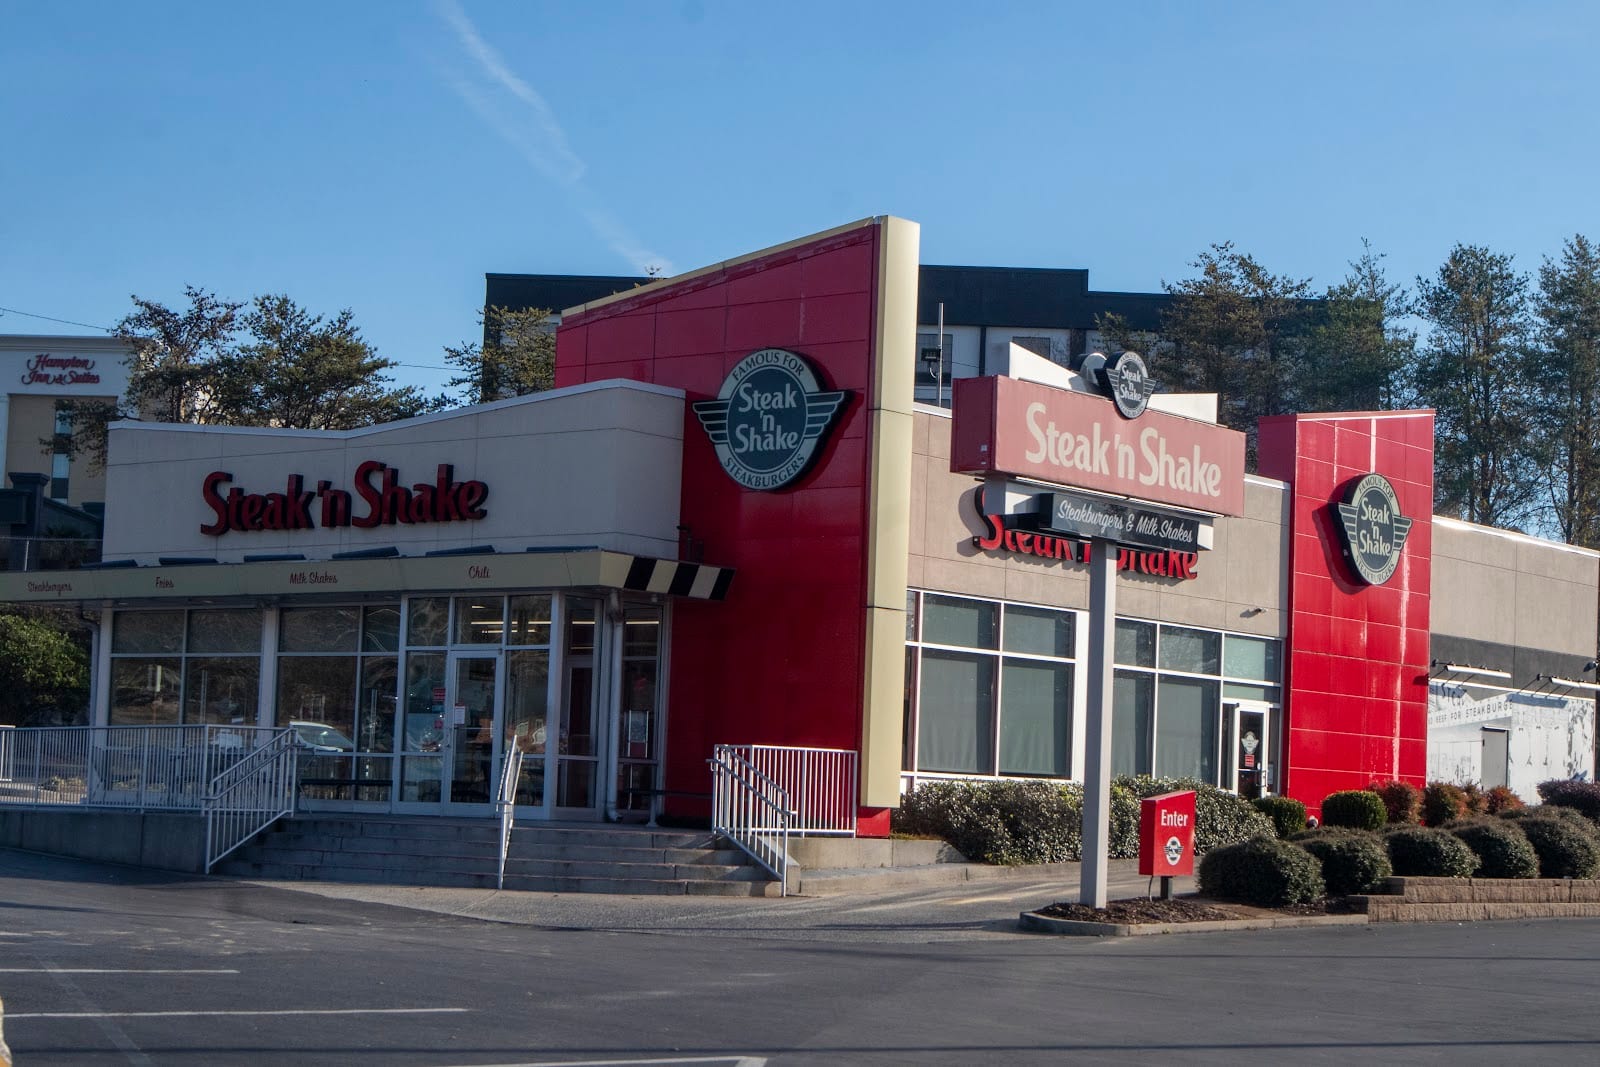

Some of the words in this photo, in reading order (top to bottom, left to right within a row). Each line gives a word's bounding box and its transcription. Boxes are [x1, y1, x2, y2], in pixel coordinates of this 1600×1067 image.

[26, 353, 95, 371] Hampton
[732, 352, 780, 381] FAMOUS
[783, 354, 805, 377] FOR
[1121, 364, 1142, 383] Steak
[21, 370, 56, 385] Inn
[738, 382, 798, 413] Steak
[1120, 384, 1142, 402] Shake
[734, 423, 799, 454] Shake
[1025, 401, 1110, 476] Steak
[1139, 426, 1222, 497] Shake
[724, 453, 805, 488] STEAKBURGERS
[201, 471, 316, 536] Steak
[351, 460, 489, 529] Shake
[1358, 476, 1382, 494] FAMOUS
[1383, 483, 1395, 500] FOR
[1057, 499, 1123, 534] Steakburgers
[1126, 513, 1135, 532] &
[1136, 515, 1159, 537] Milk
[1159, 519, 1193, 543] Shakes
[1361, 497, 1390, 525] Steak
[1360, 530, 1391, 556] Shake
[289, 571, 308, 585] Milk
[308, 570, 338, 584] Shakes
[468, 565, 490, 579] Chili
[1450, 710, 1462, 720] FOR
[1161, 809, 1189, 827] Enter
